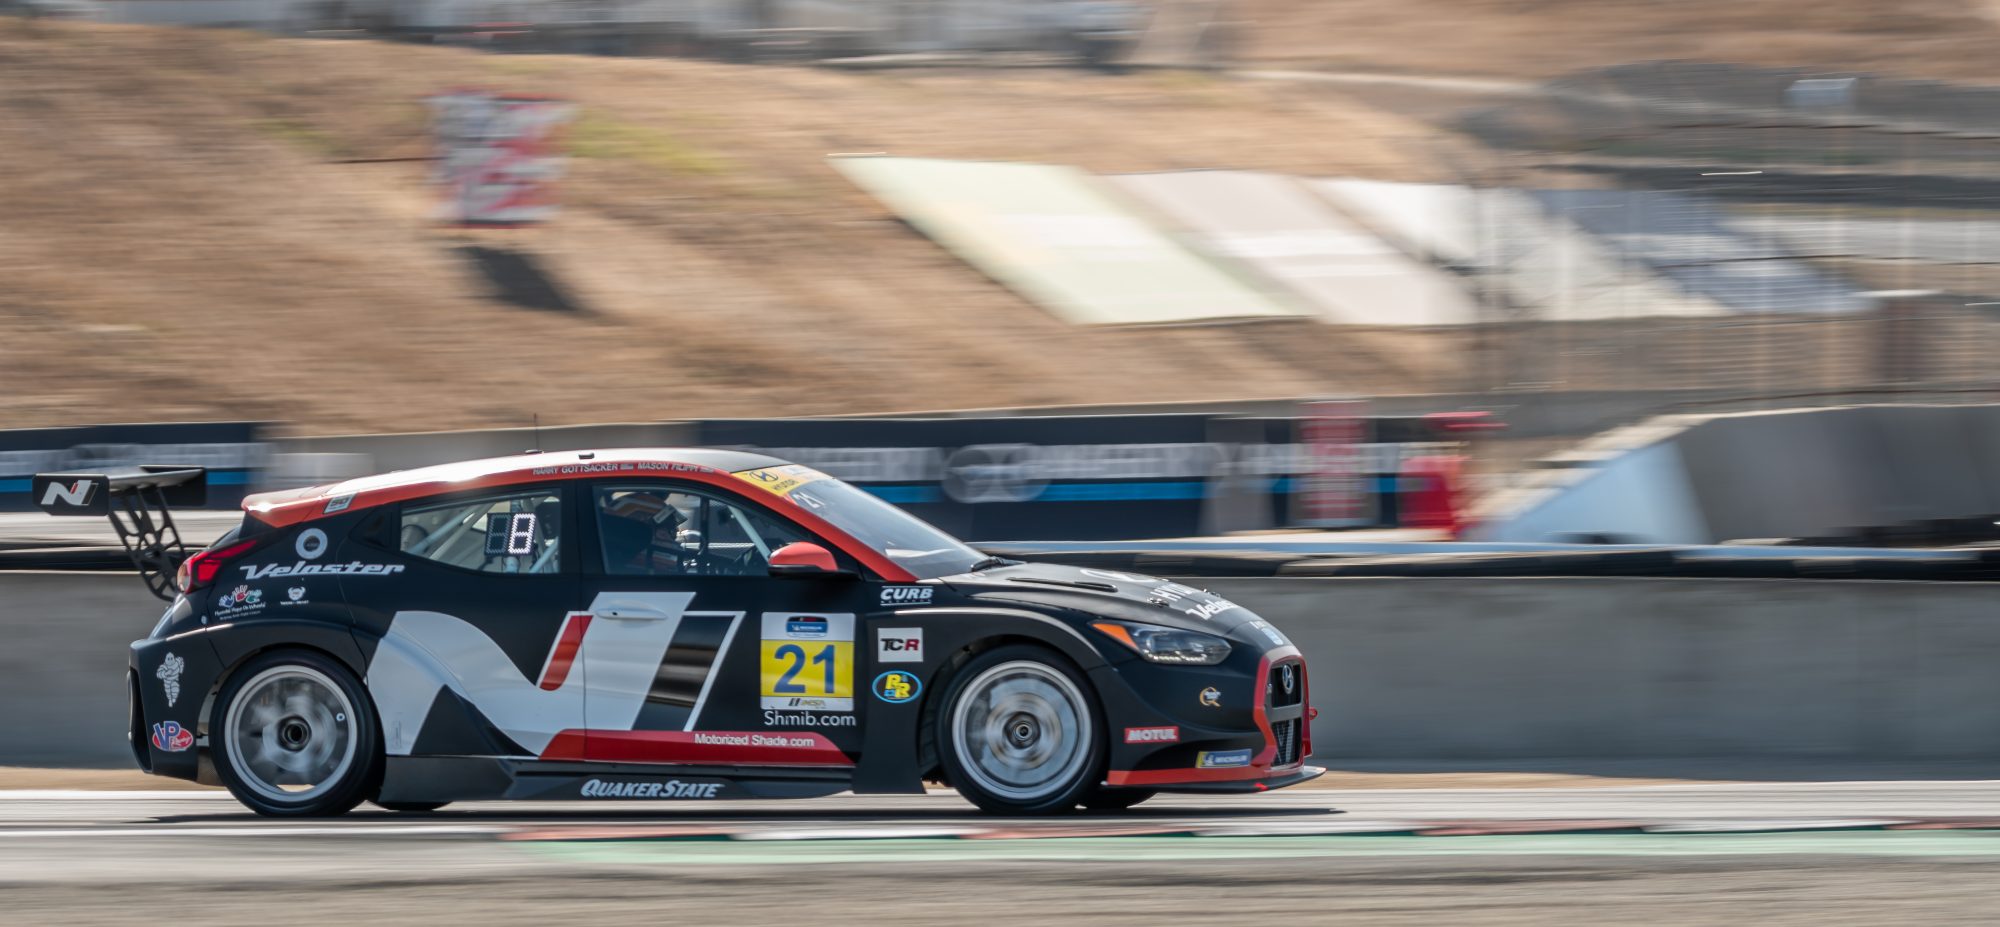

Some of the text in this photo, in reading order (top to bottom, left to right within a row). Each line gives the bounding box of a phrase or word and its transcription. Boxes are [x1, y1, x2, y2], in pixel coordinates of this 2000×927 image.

[561, 463, 618, 474] GOTTSACKER
[637, 462, 669, 471] MASON
[240, 561, 405, 580] Veloster
[880, 588, 933, 600] CURB
[881, 638, 920, 651] TCR
[774, 644, 835, 694] 21
[764, 709, 857, 726] Shmib.com
[153, 721, 180, 751] VP
[695, 733, 814, 747] Motorized Shade.com
[1127, 728, 1178, 741] MOTUL
